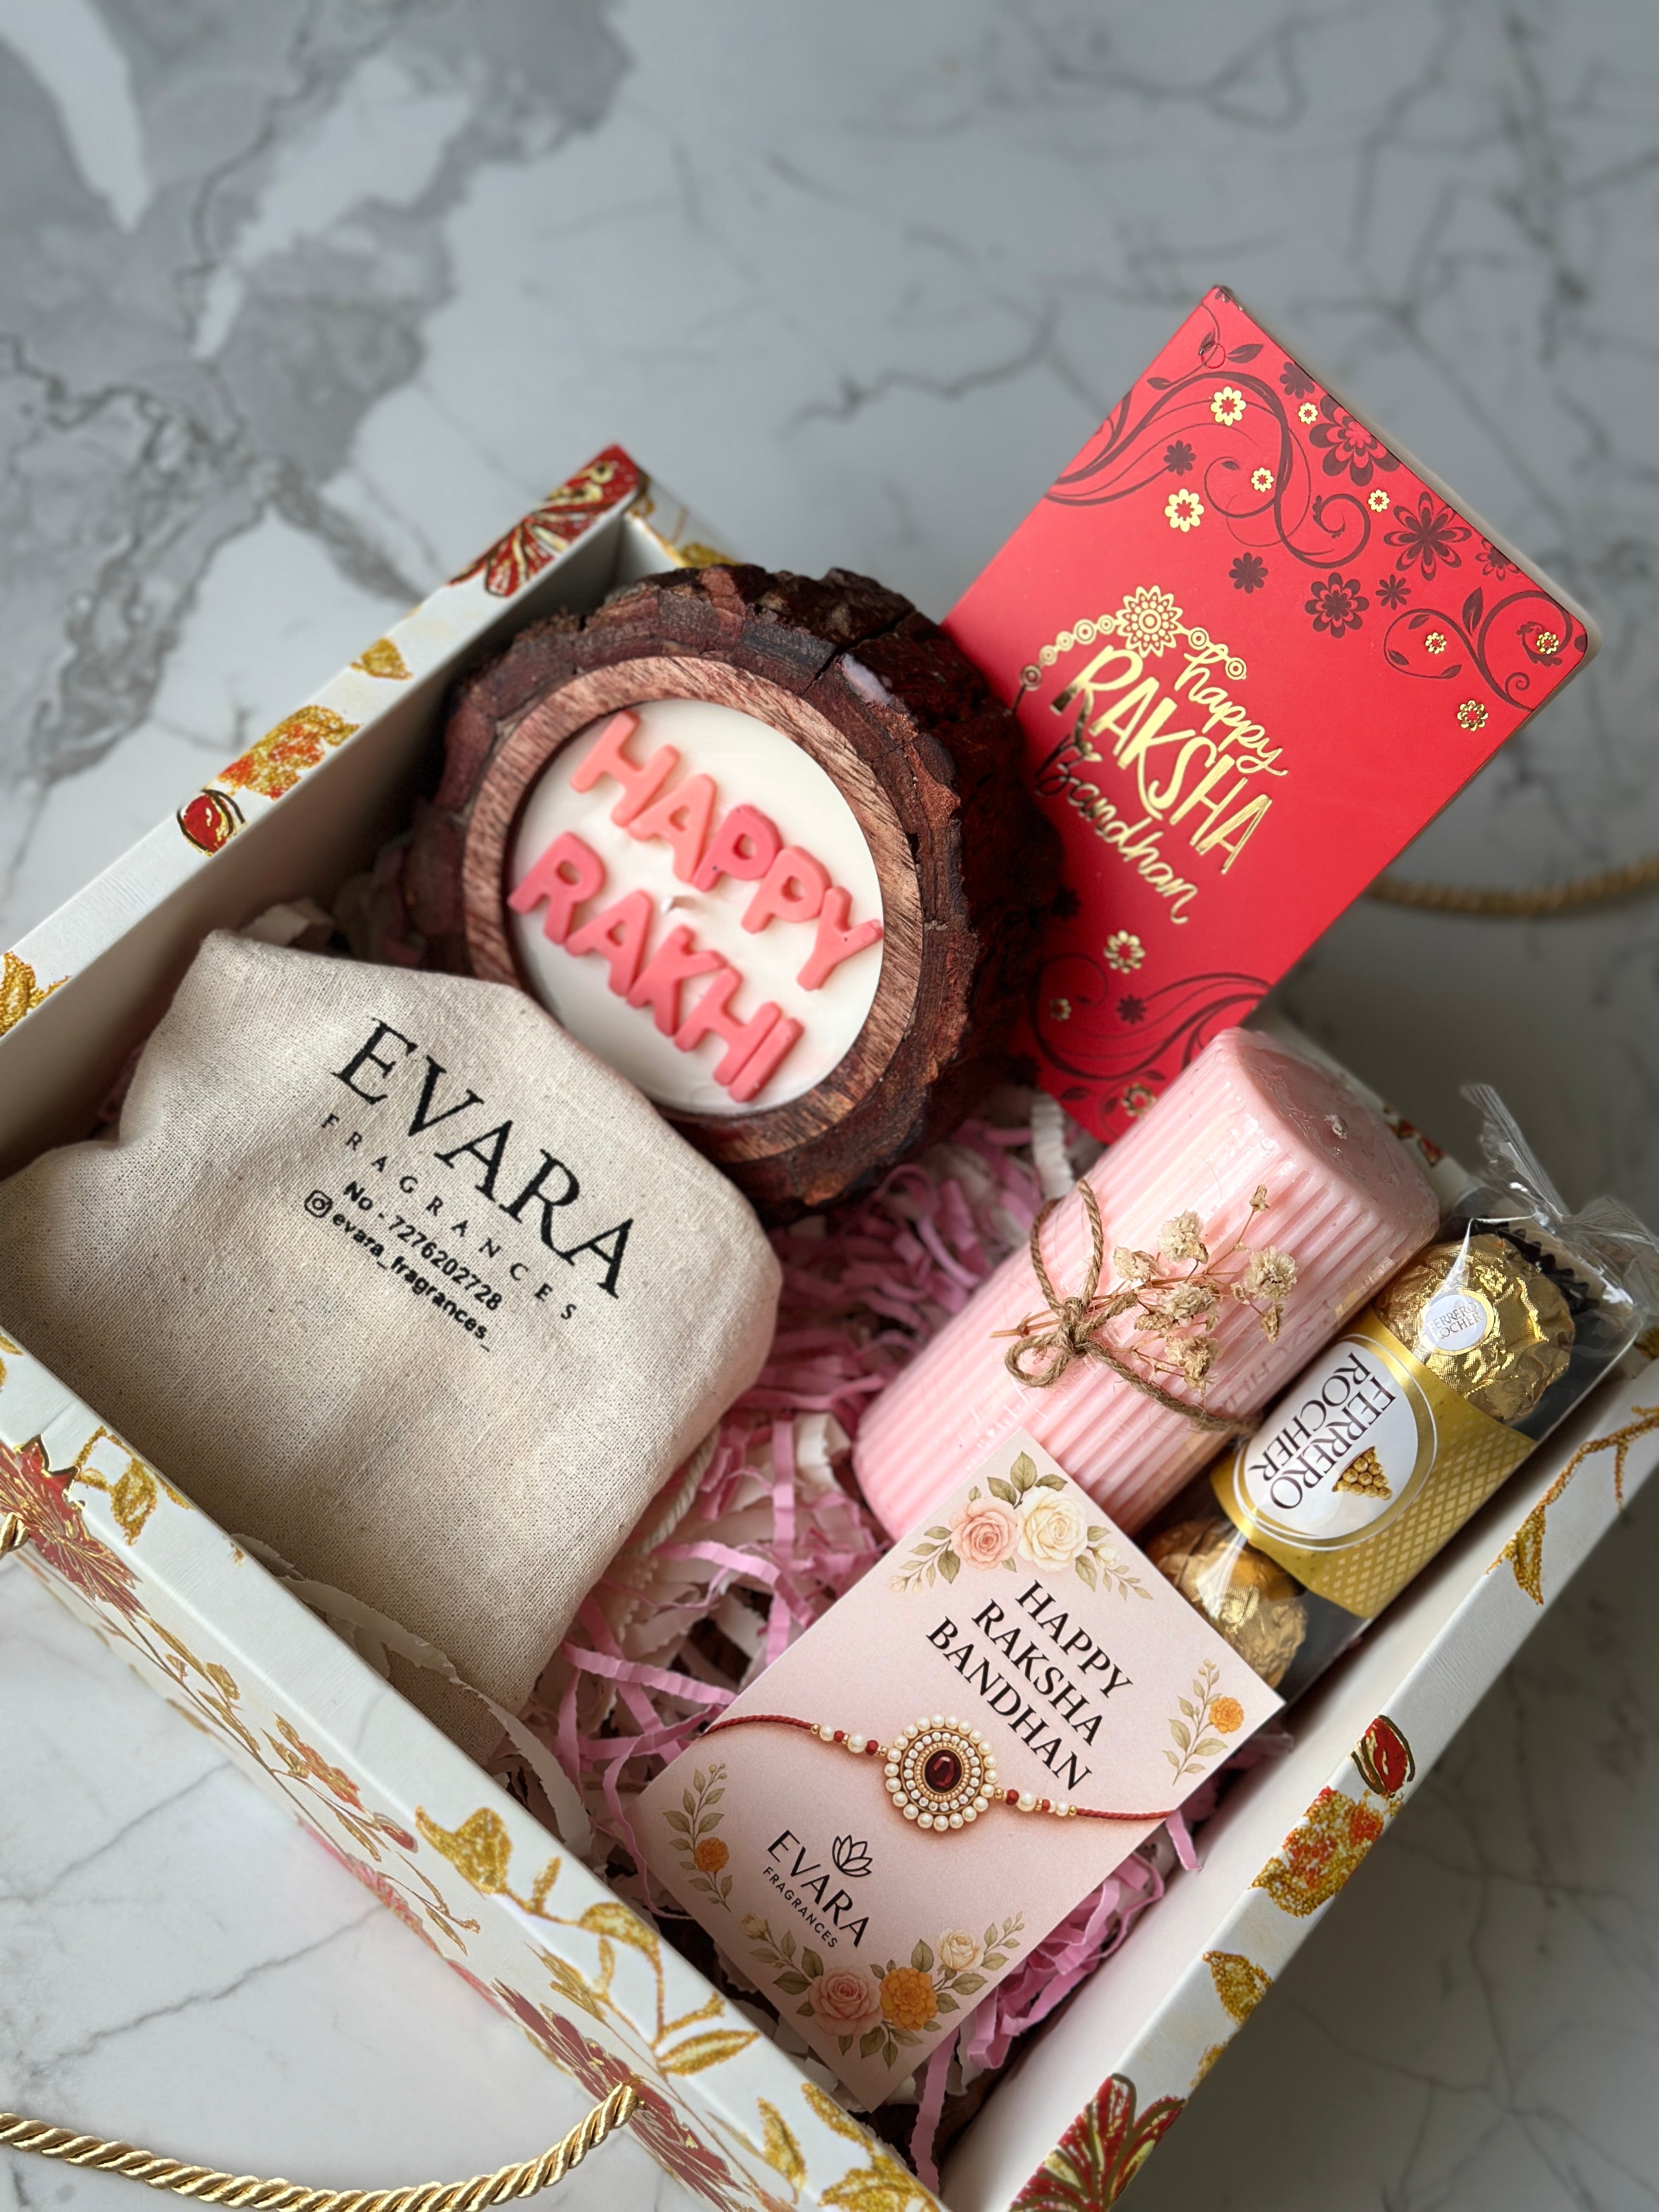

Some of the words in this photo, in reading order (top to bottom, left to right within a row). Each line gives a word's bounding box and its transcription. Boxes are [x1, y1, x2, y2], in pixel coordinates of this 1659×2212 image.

[1050, 646, 1272, 874] RAKSHA
[1175, 643, 1288, 776] happy
[570, 709, 884, 992] HAPPY
[507, 831, 805, 1103] RAKHI
[321, 1113, 577, 1321] FRAGRANCES
[331, 1017, 634, 1299] EVARA
[343, 1180, 374, 1211] No
[388, 1214, 503, 1311] 7276202728
[1426, 1301, 1479, 1333] FERRERO
[1248, 1351, 1371, 1481] ROCHER
[1270, 1375, 1397, 1510] FERRERO
[926, 1616, 1093, 1791] BANDHAN
[971, 1598, 1104, 1747] RAKSHA
[1015, 1579, 1133, 1699] HAPPY
[763, 1866, 838, 1948] FRAGRANCES
[767, 1829, 870, 1948] EVARA
